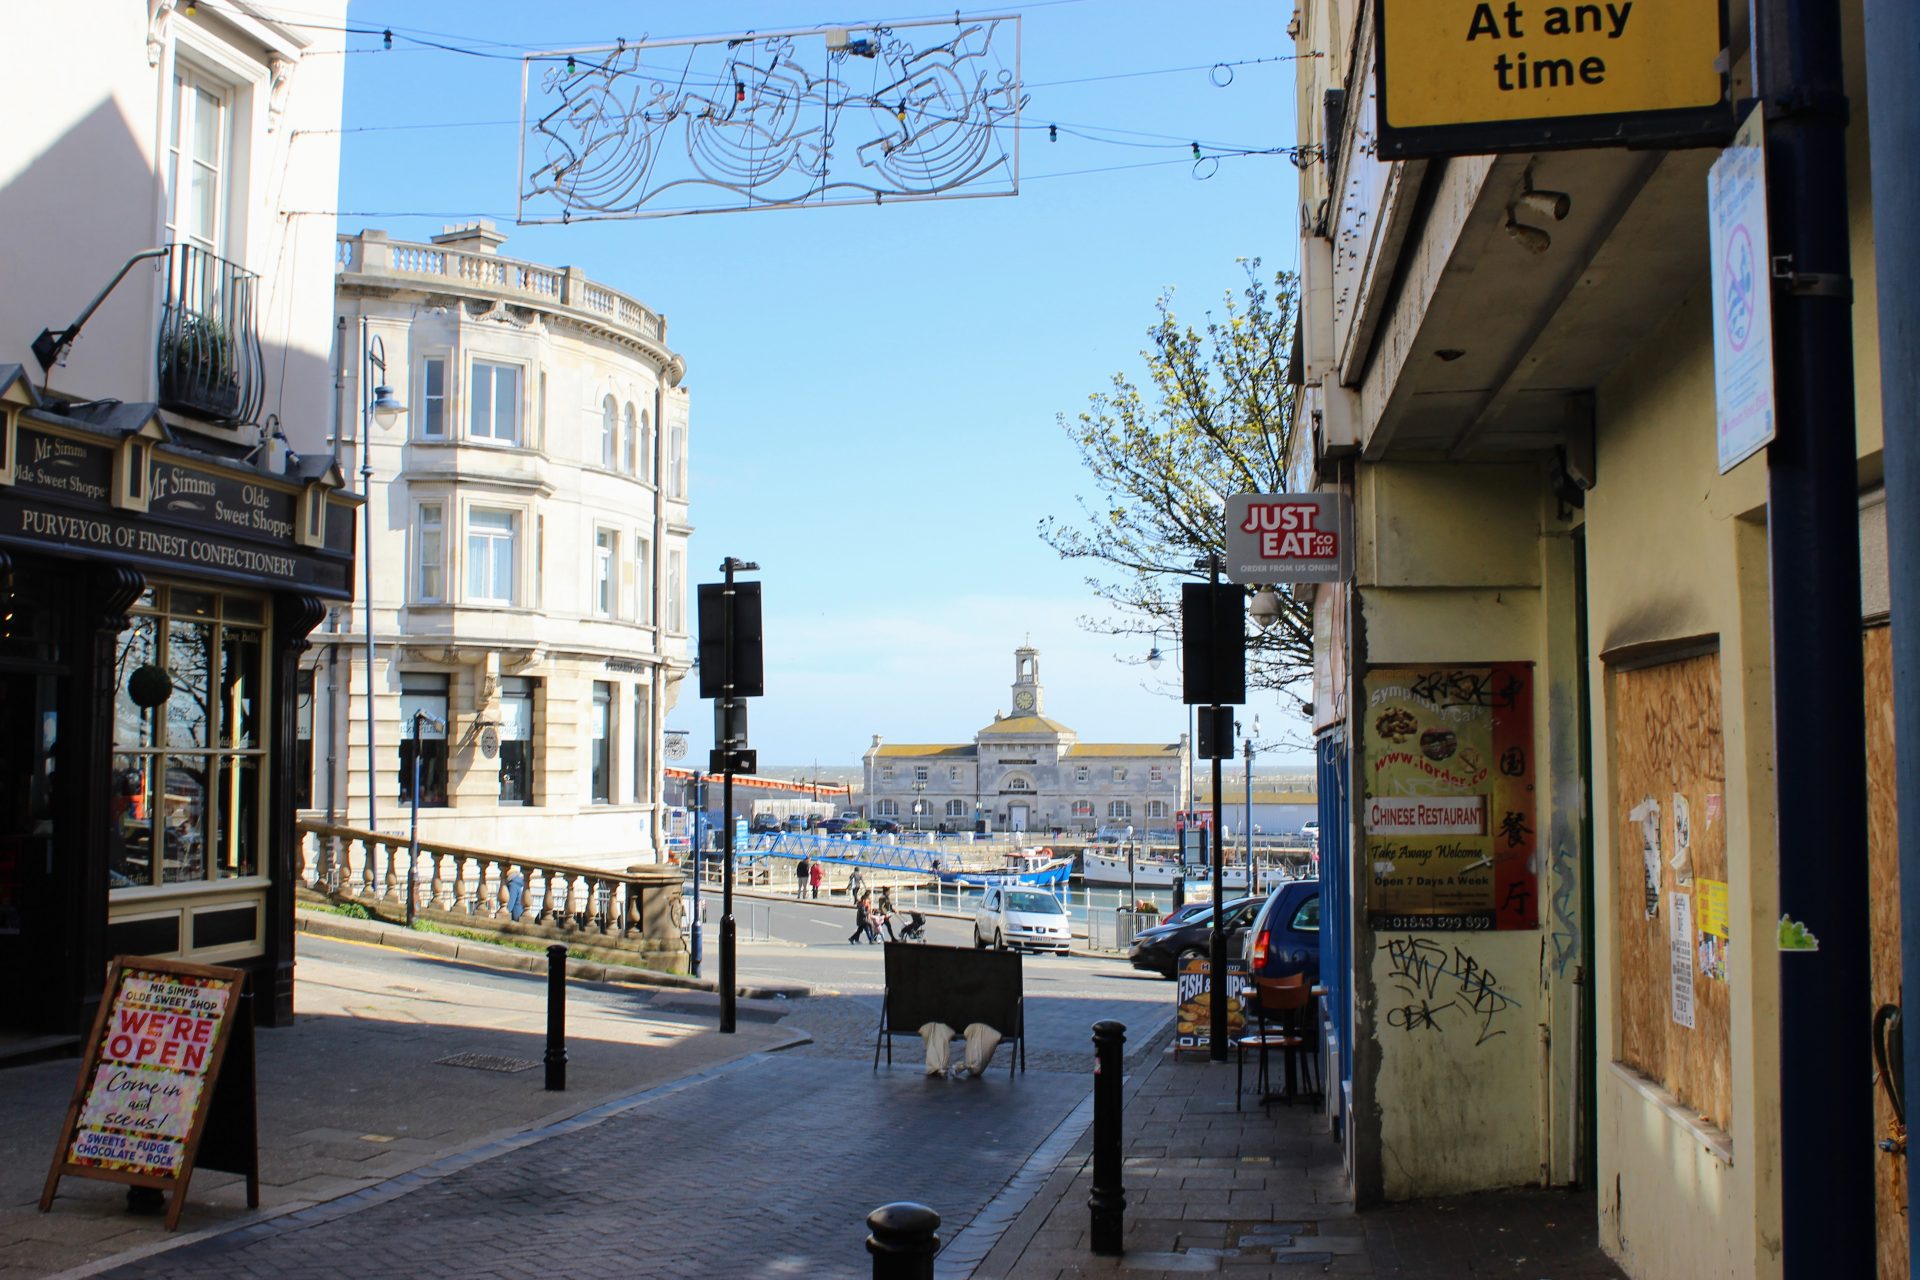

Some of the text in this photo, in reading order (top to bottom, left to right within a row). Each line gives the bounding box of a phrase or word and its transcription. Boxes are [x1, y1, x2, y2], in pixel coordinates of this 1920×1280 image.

[1466, 1, 1633, 41] At any
[1493, 52, 1606, 91] time
[33, 438, 87, 463] Mr Simms
[37, 469, 67, 489] Sweet
[69, 474, 107, 498] Shoppe
[149, 467, 216, 501] Mr Simms
[242, 484, 270, 508] Olde
[215, 502, 294, 538] Sweet Shoppe
[1244, 505, 1317, 531] JUST
[22, 509, 298, 577] PURVEYOR OF FINEST CONFECTIONERY
[1263, 532, 1316, 556] EAT
[1240, 564, 1338, 573] ORDER FROM US ONLINE
[1371, 842, 1483, 866] Take Aways Welcome
[1374, 876, 1489, 887] Open 7 Days A Week
[125, 992, 218, 1012] OLDE SWEET SHOP
[150, 983, 199, 998] MR SIMMS
[1178, 974, 1203, 1006] FISH
[1227, 975, 1246, 1008] IPS
[120, 1010, 213, 1044] WE'RE
[110, 1035, 206, 1069] OPEN
[1180, 1037, 1239, 1047] OPN
[106, 1071, 183, 1097] Come in
[128, 1096, 153, 1111] and
[104, 1112, 169, 1130] see us!
[77, 1144, 135, 1162] CHOCOLATE
[146, 1153, 174, 1167] ROCK
[86, 1134, 126, 1148] SWEETS
[136, 1141, 171, 1155] FUDGE
